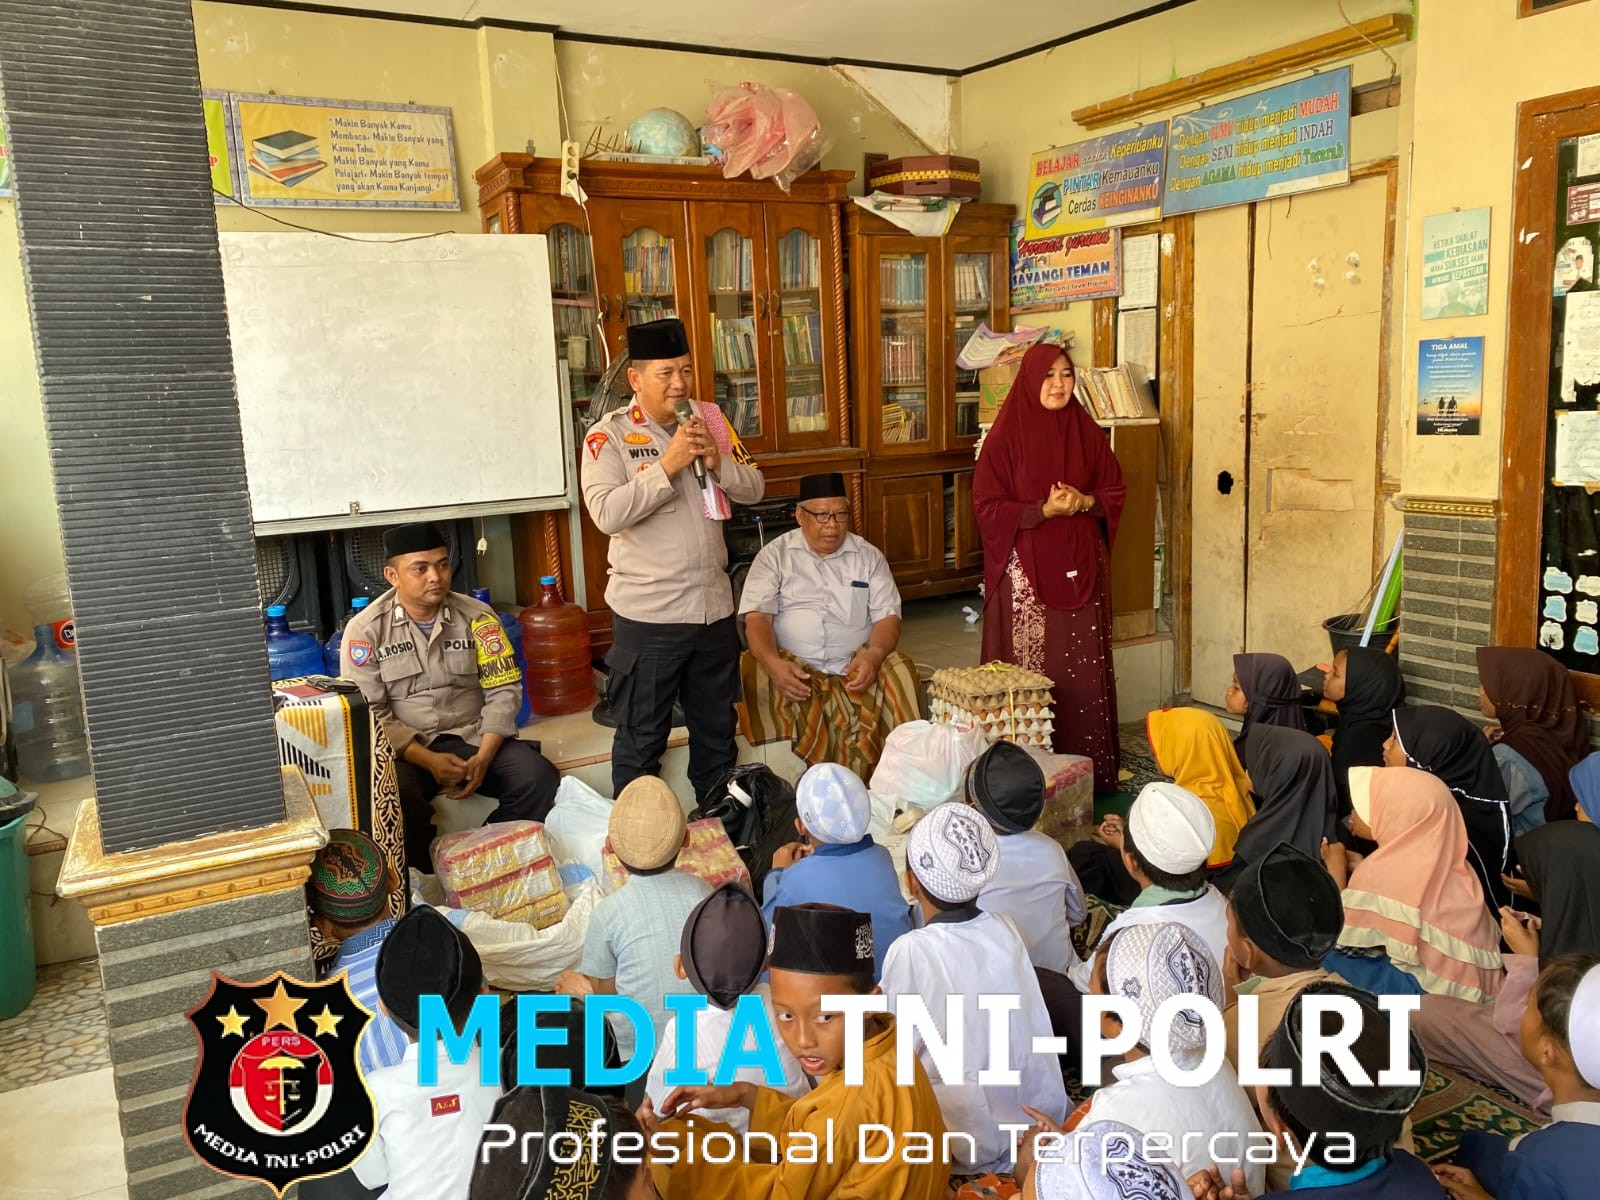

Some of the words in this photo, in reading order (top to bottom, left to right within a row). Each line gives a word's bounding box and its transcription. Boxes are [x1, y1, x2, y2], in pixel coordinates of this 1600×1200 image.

[335, 118, 358, 128] Makin
[360, 119, 388, 131] Banyak
[390, 121, 411, 130] Kamu
[1178, 131, 1209, 149] Dengan
[1211, 121, 1234, 140] ILMU
[1235, 115, 1259, 133] hidup
[1261, 103, 1297, 128] menjadi
[1299, 93, 1339, 117] MUDAH
[331, 143, 354, 152] Kamu
[372, 132, 395, 142] Makin
[397, 133, 425, 144] Banyak
[426, 136, 444, 146] yang
[1179, 152, 1210, 169] Dengan
[1211, 144, 1233, 162] SENI
[1234, 138, 1259, 156] hidup
[1261, 128, 1297, 151] menjadi
[1299, 119, 1334, 142] INDAH
[334, 155, 357, 165] Makin
[359, 156, 387, 168] Banyak
[389, 159, 407, 168] yang
[408, 159, 429, 168] Kamu
[1036, 152, 1080, 177] BELAJAR
[1169, 174, 1201, 192] Dengan
[1201, 164, 1236, 186] AGAMA
[1237, 160, 1262, 180] hidup
[1264, 150, 1301, 174] menjadi
[370, 169, 393, 179] Makin
[394, 171, 422, 182] Banyak
[424, 172, 449, 183] tempat
[1063, 171, 1101, 195] PINTAR
[1101, 160, 1160, 186] Kemauanku
[336, 183, 355, 192] yang
[376, 182, 398, 191] Kamu
[1068, 195, 1097, 215] Cerdas
[1098, 183, 1159, 209] KEINGINANKU
[1433, 236, 1454, 249] KETIKA
[1455, 230, 1478, 244] SHALAT
[1446, 238, 1488, 258] KEBIASAAN
[1444, 255, 1470, 271] SUKSES
[1012, 266, 1063, 287] SAYANGI
[1066, 260, 1110, 280] TEMAN
[1431, 343, 1448, 351] TIGA
[1448, 342, 1468, 350] AMAL
[629, 448, 660, 459] WITO
[376, 641, 413, 660] A.ROSID
